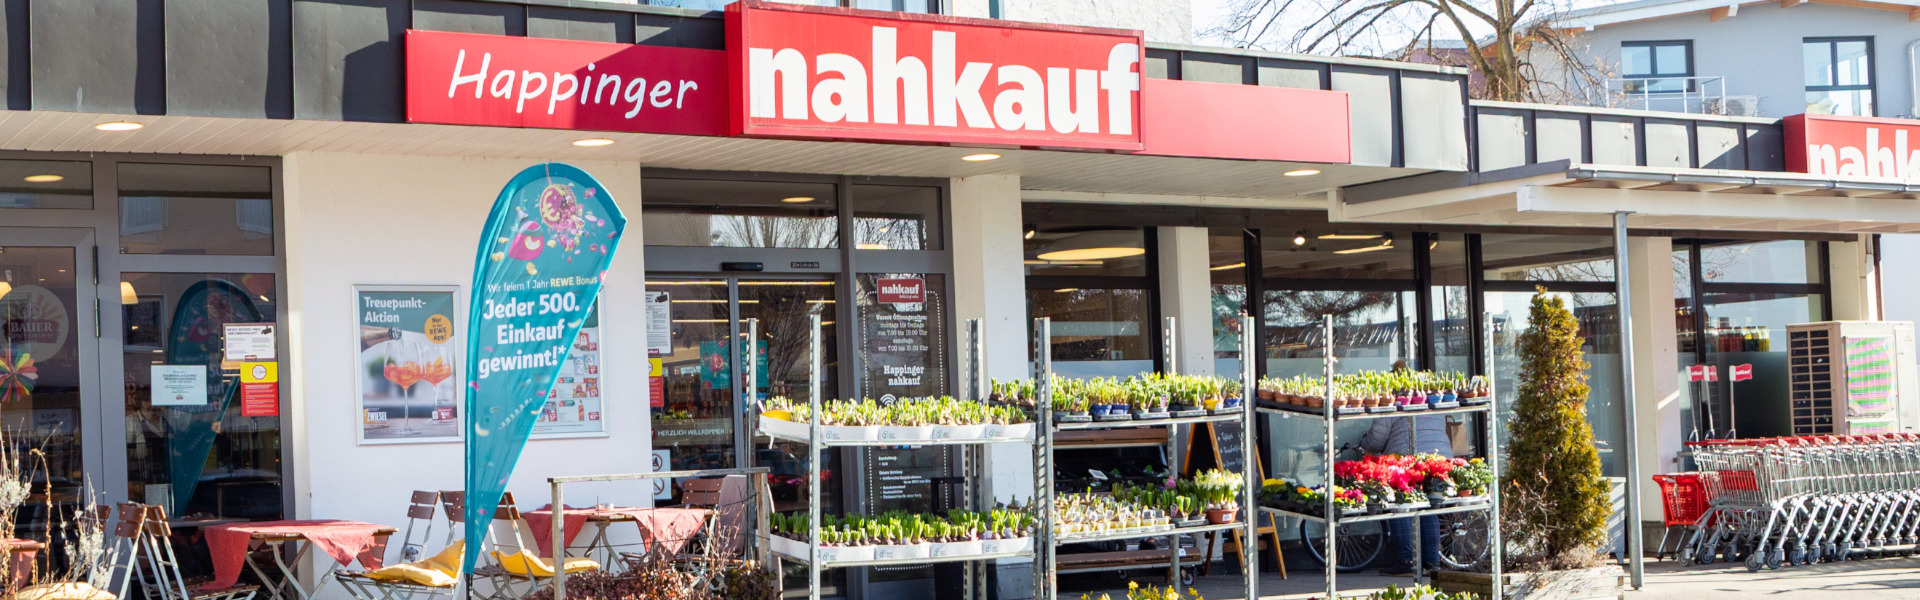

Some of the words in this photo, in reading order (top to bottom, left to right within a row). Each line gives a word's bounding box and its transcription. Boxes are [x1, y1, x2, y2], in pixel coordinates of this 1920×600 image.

[448, 48, 698, 118] Happinger
[750, 26, 1140, 135] nahkauf
[488, 284, 501, 293] Wir
[503, 282, 524, 291] feiern
[526, 281, 530, 289] 1
[532, 279, 548, 289] Jahr
[550, 277, 574, 287] REWE
[576, 276, 598, 285] Bonus
[881, 284, 919, 294] nahkauf
[363, 296, 427, 310] Treuepunkt-
[483, 297, 535, 320] Jeder
[539, 292, 580, 315] 500.
[364, 311, 400, 323] Aktion
[11, 322, 52, 332] BAUER
[429, 327, 447, 335] REWE
[497, 318, 565, 345] Einkauf
[883, 365, 925, 376] Happinger
[888, 376, 921, 386] nahkauf
[367, 411, 387, 421] ZWIESEL
[657, 429, 687, 437] HERZLICH
[687, 428, 725, 436] WILLKOMMEN
